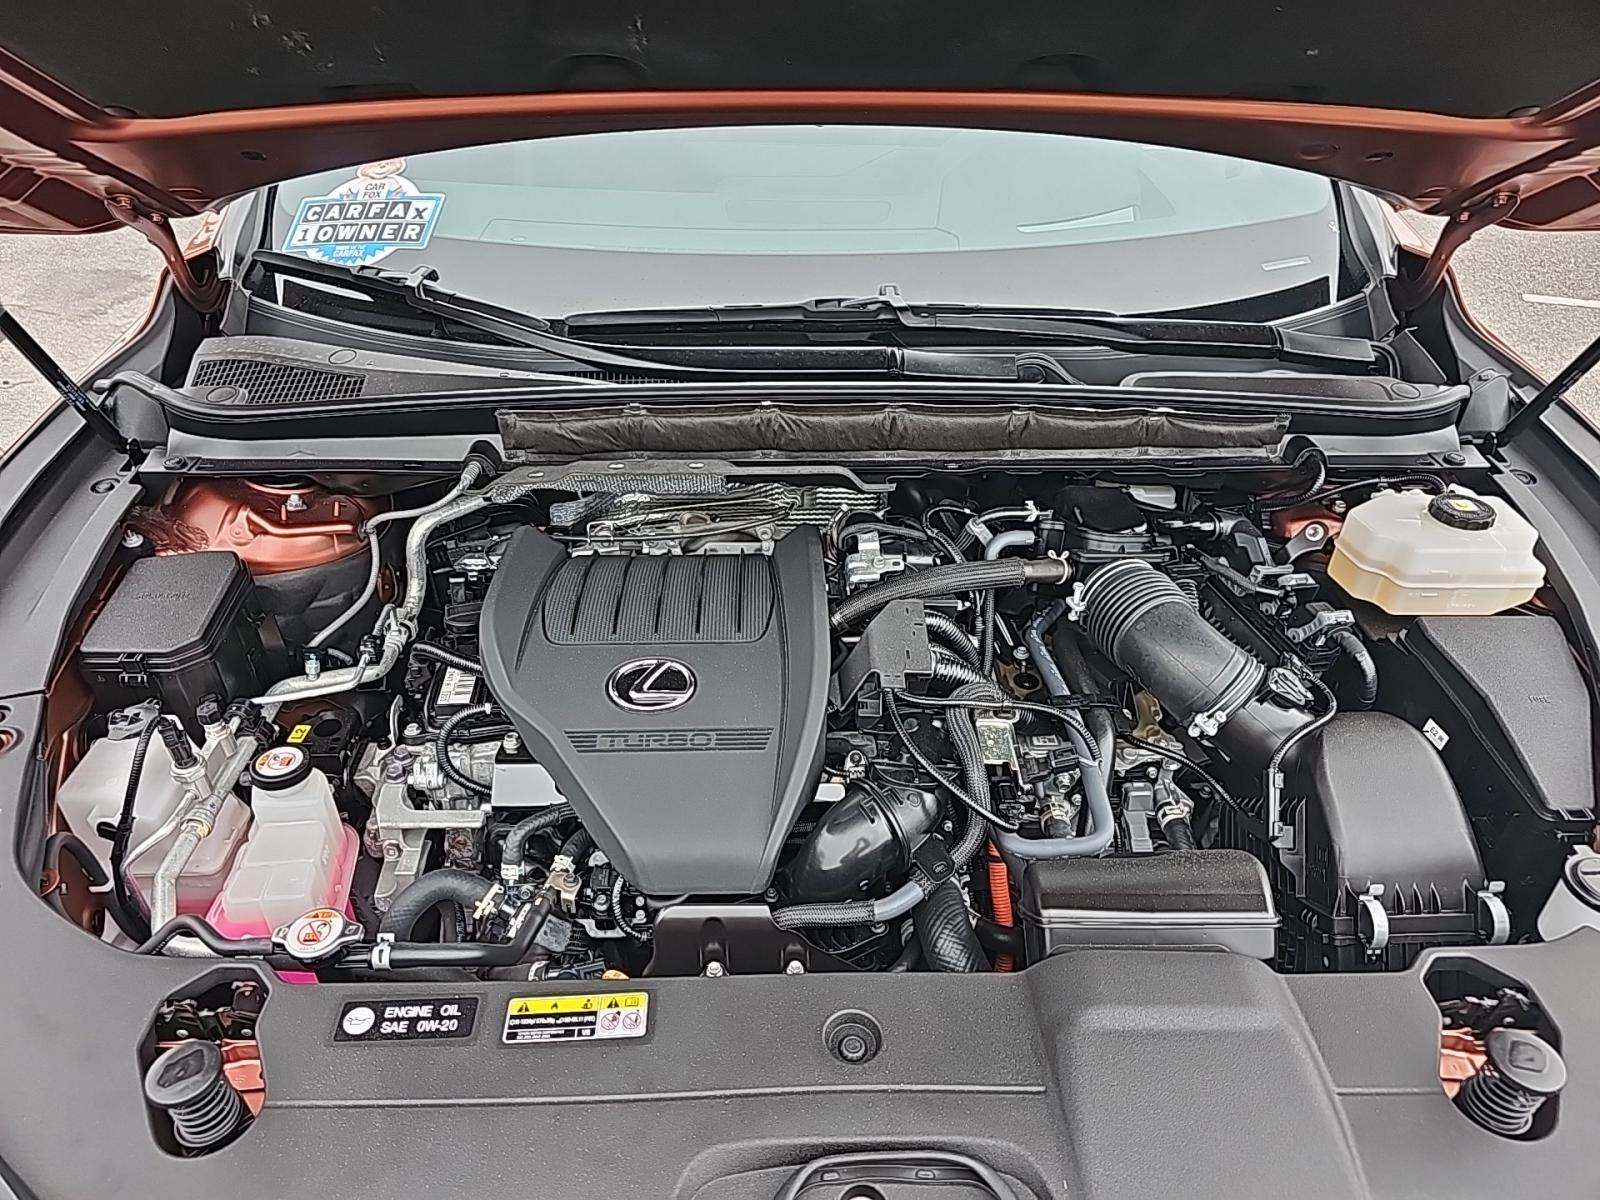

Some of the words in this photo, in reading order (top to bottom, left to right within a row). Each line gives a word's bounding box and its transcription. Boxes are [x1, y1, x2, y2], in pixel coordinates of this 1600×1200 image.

[364, 183, 386, 191] CAR
[362, 191, 382, 199] FOX
[305, 204, 428, 222] CARFAX
[297, 228, 309, 242] 1
[317, 224, 421, 242] OWNER
[290, 728, 307, 740] L2
[598, 733, 716, 748] TURBO
[384, 1006, 433, 1018] ENGINE
[440, 1005, 461, 1017] OIL
[380, 1021, 408, 1034] SAE
